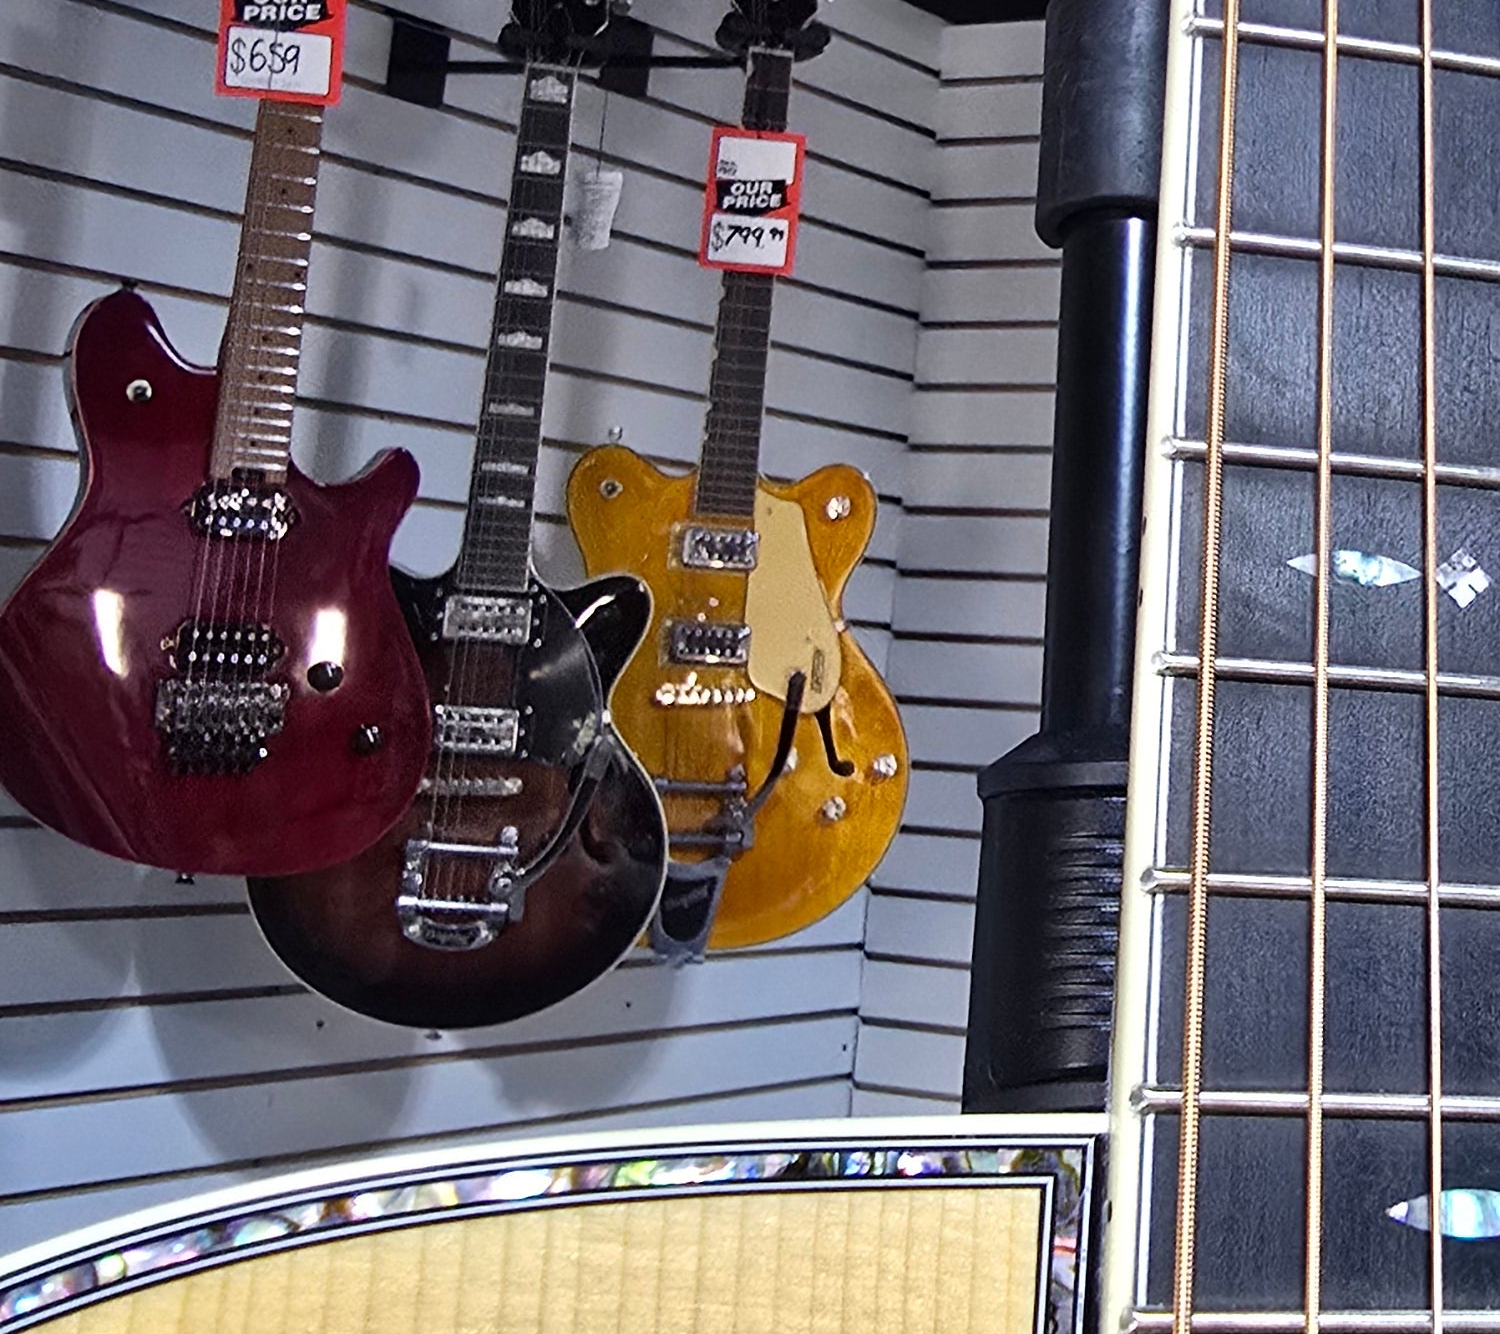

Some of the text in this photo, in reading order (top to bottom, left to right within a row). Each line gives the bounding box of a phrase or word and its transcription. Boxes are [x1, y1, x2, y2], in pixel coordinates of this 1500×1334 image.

[243, 3, 322, 22] PRICE
[230, 37, 300, 76] $659
[730, 181, 773, 196] OUR
[722, 193, 782, 210] PRICE
